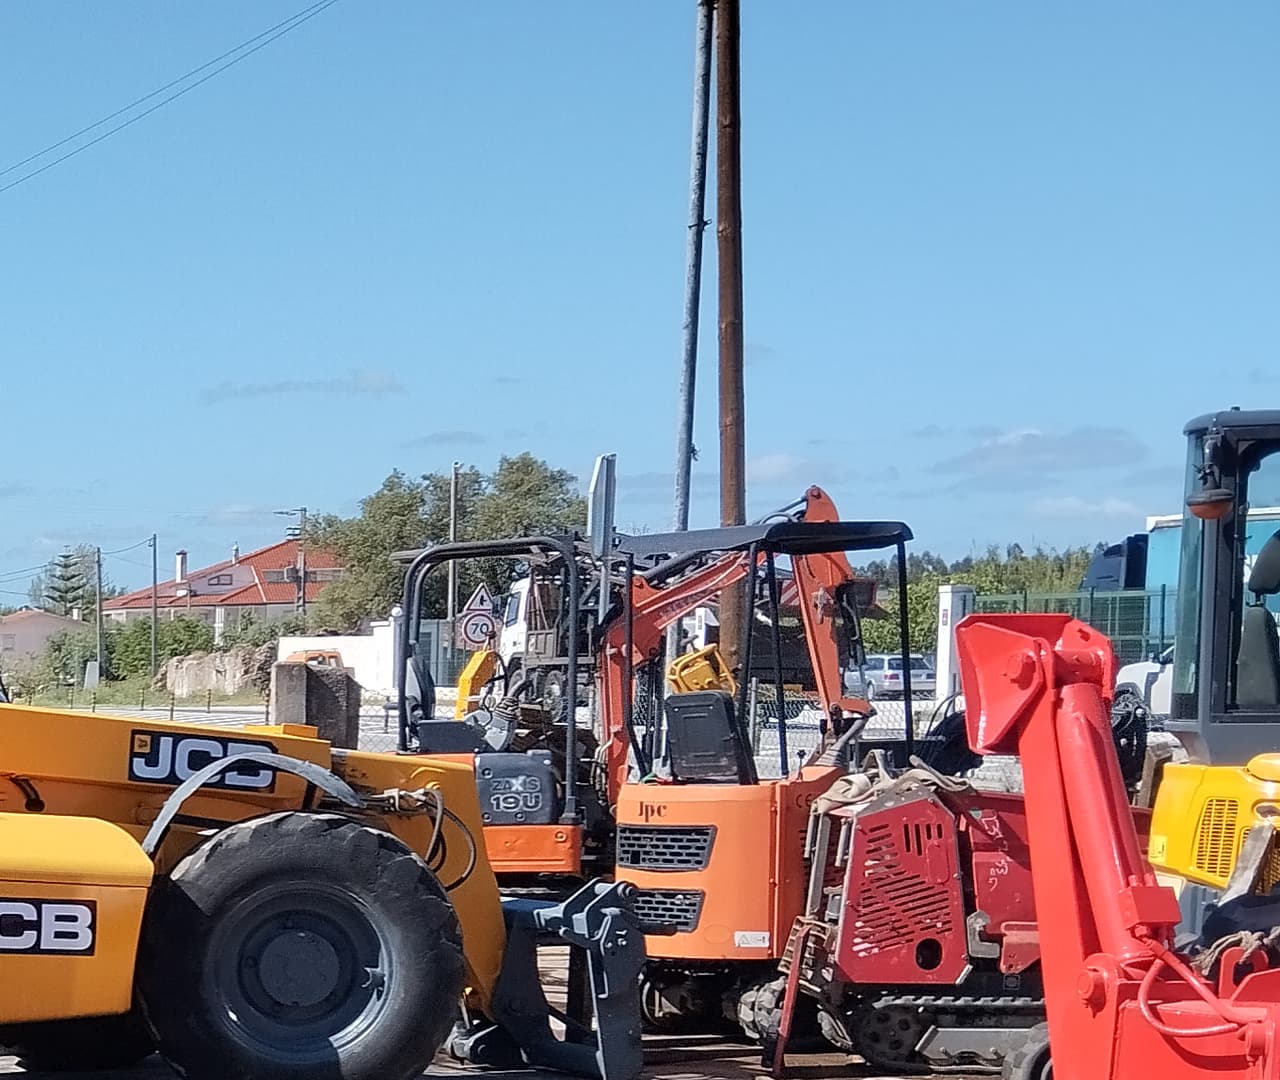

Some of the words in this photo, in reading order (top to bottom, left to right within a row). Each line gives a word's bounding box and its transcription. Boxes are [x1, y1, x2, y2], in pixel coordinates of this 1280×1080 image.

[471, 623, 489, 635] 70
[490, 775, 541, 793] ZAXIS
[490, 793, 542, 812] 19U
